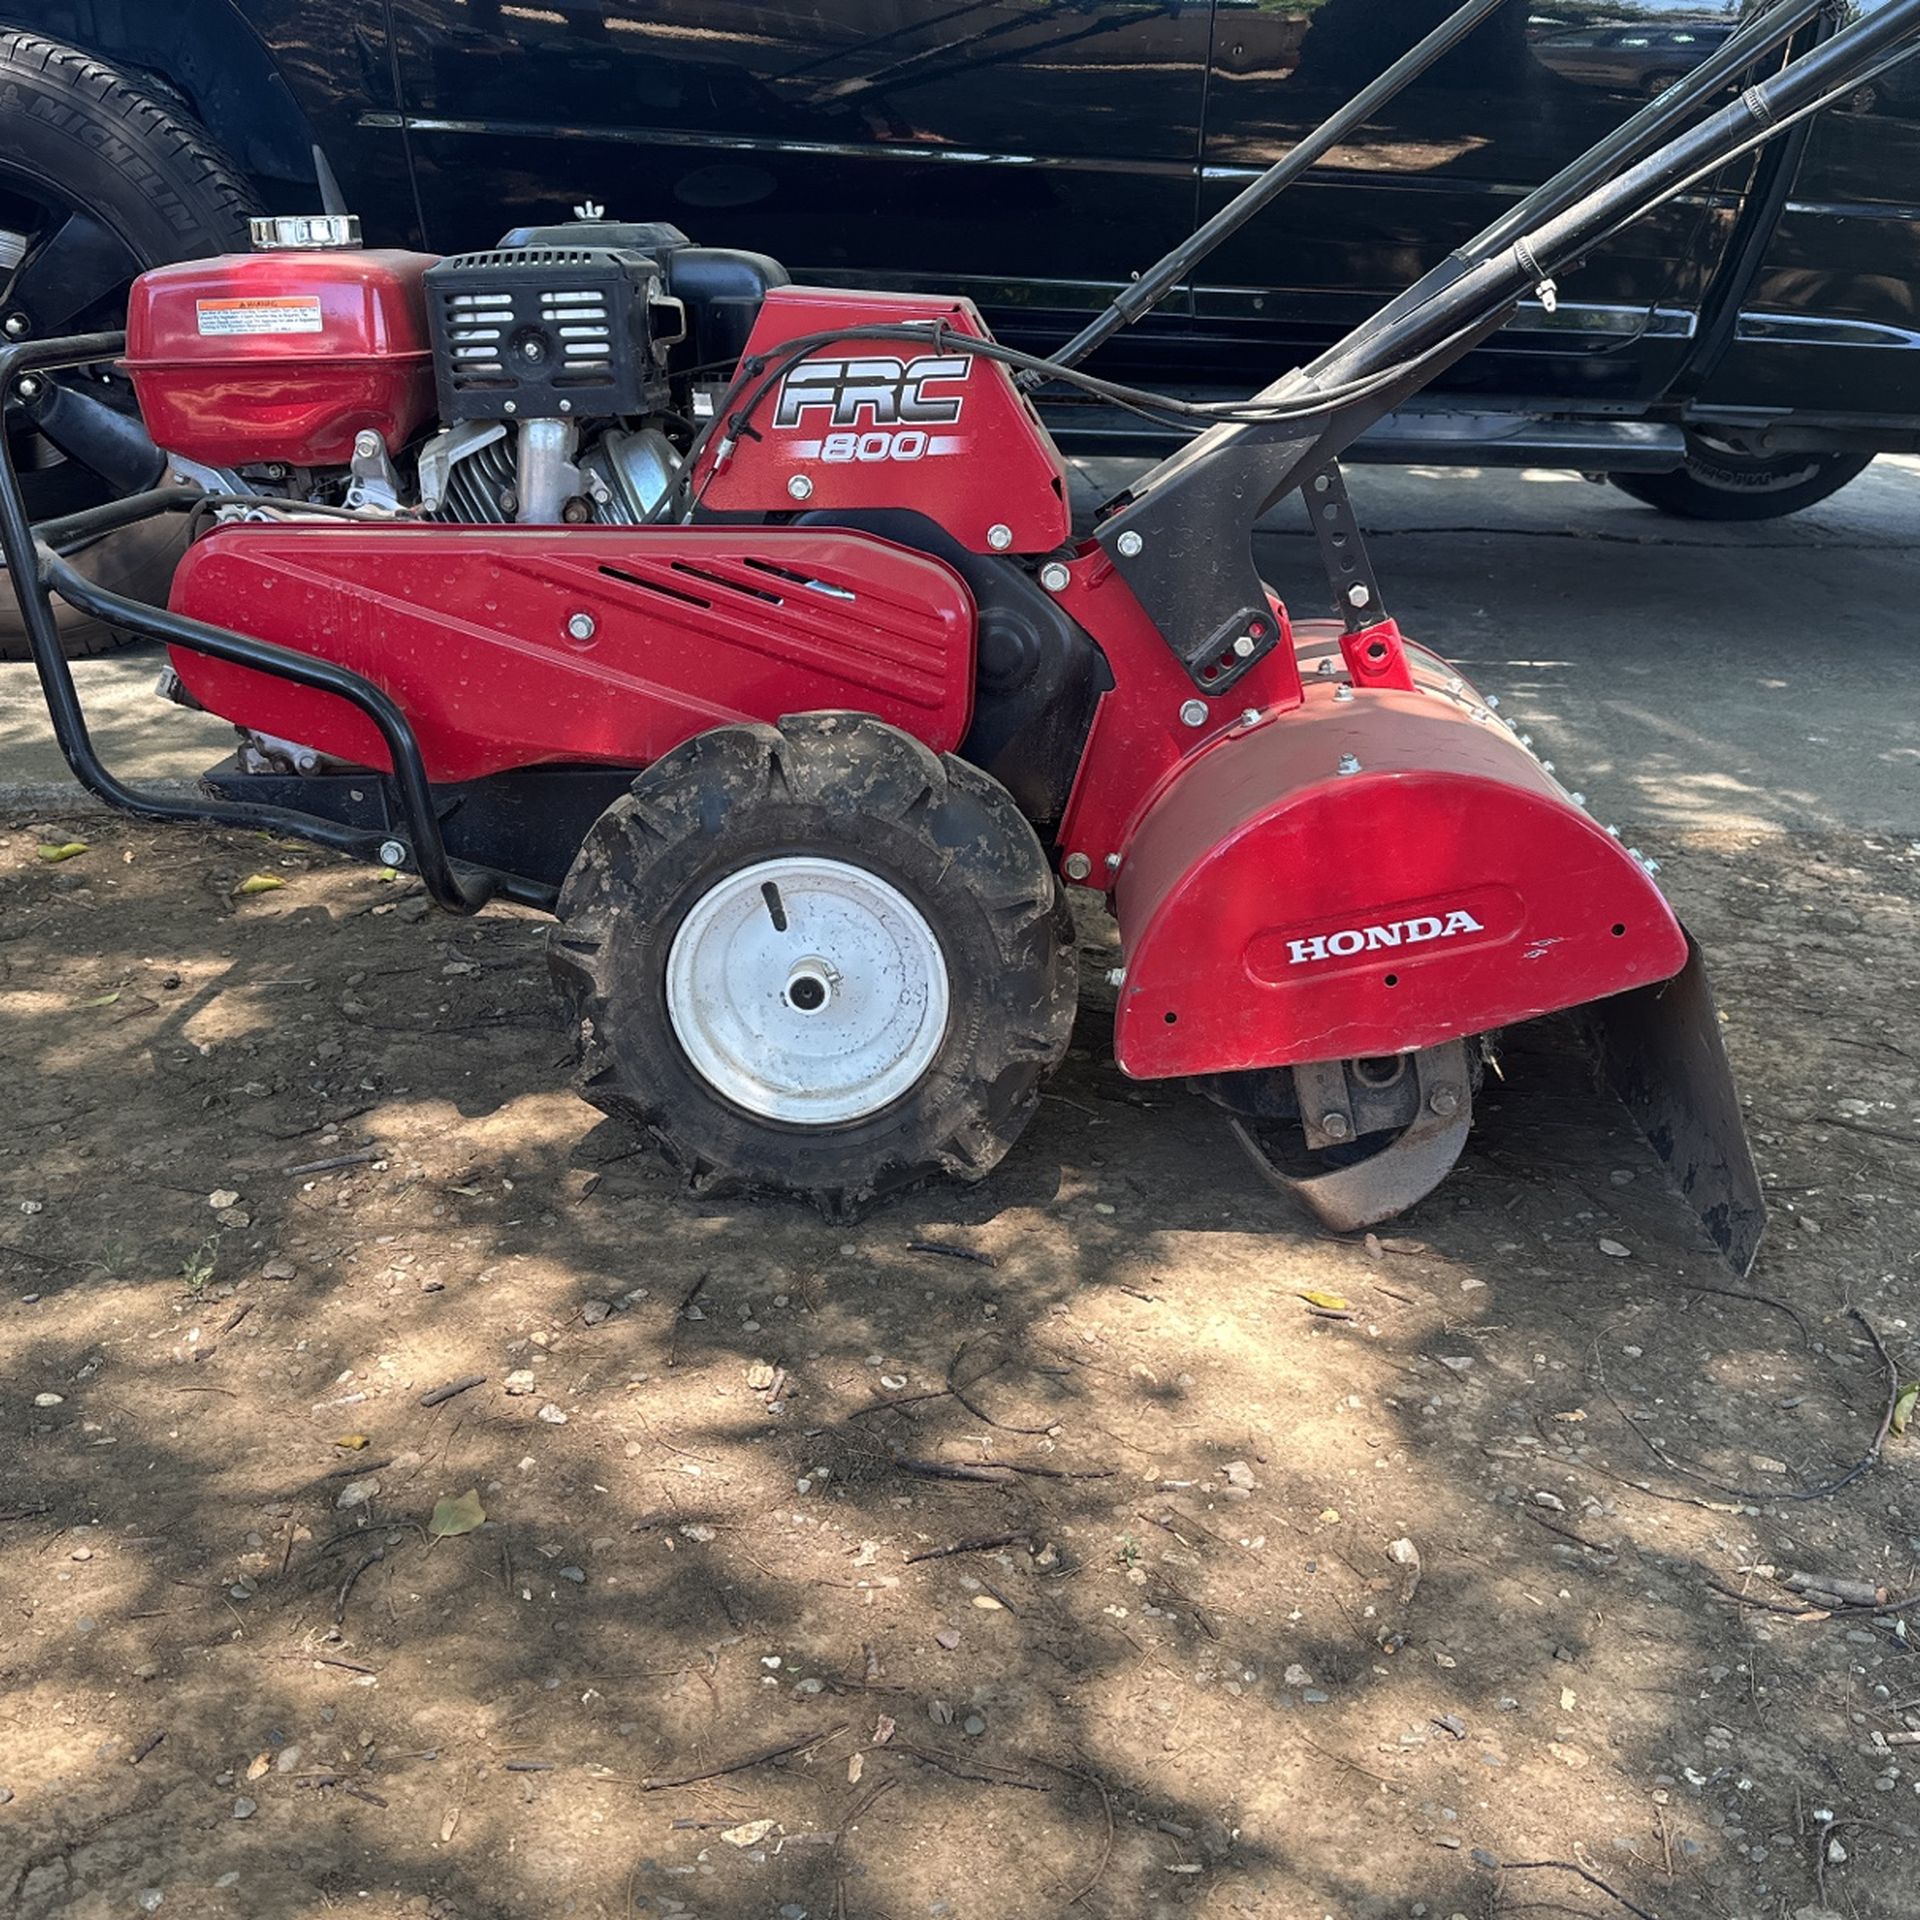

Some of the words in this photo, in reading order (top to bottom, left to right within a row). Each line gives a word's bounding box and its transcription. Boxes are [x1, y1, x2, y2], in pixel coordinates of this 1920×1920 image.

[31, 96, 198, 231] MICHELIN
[773, 356, 974, 427] FRC
[821, 431, 929, 463] 800
[1286, 909, 1485, 964] HONDA
